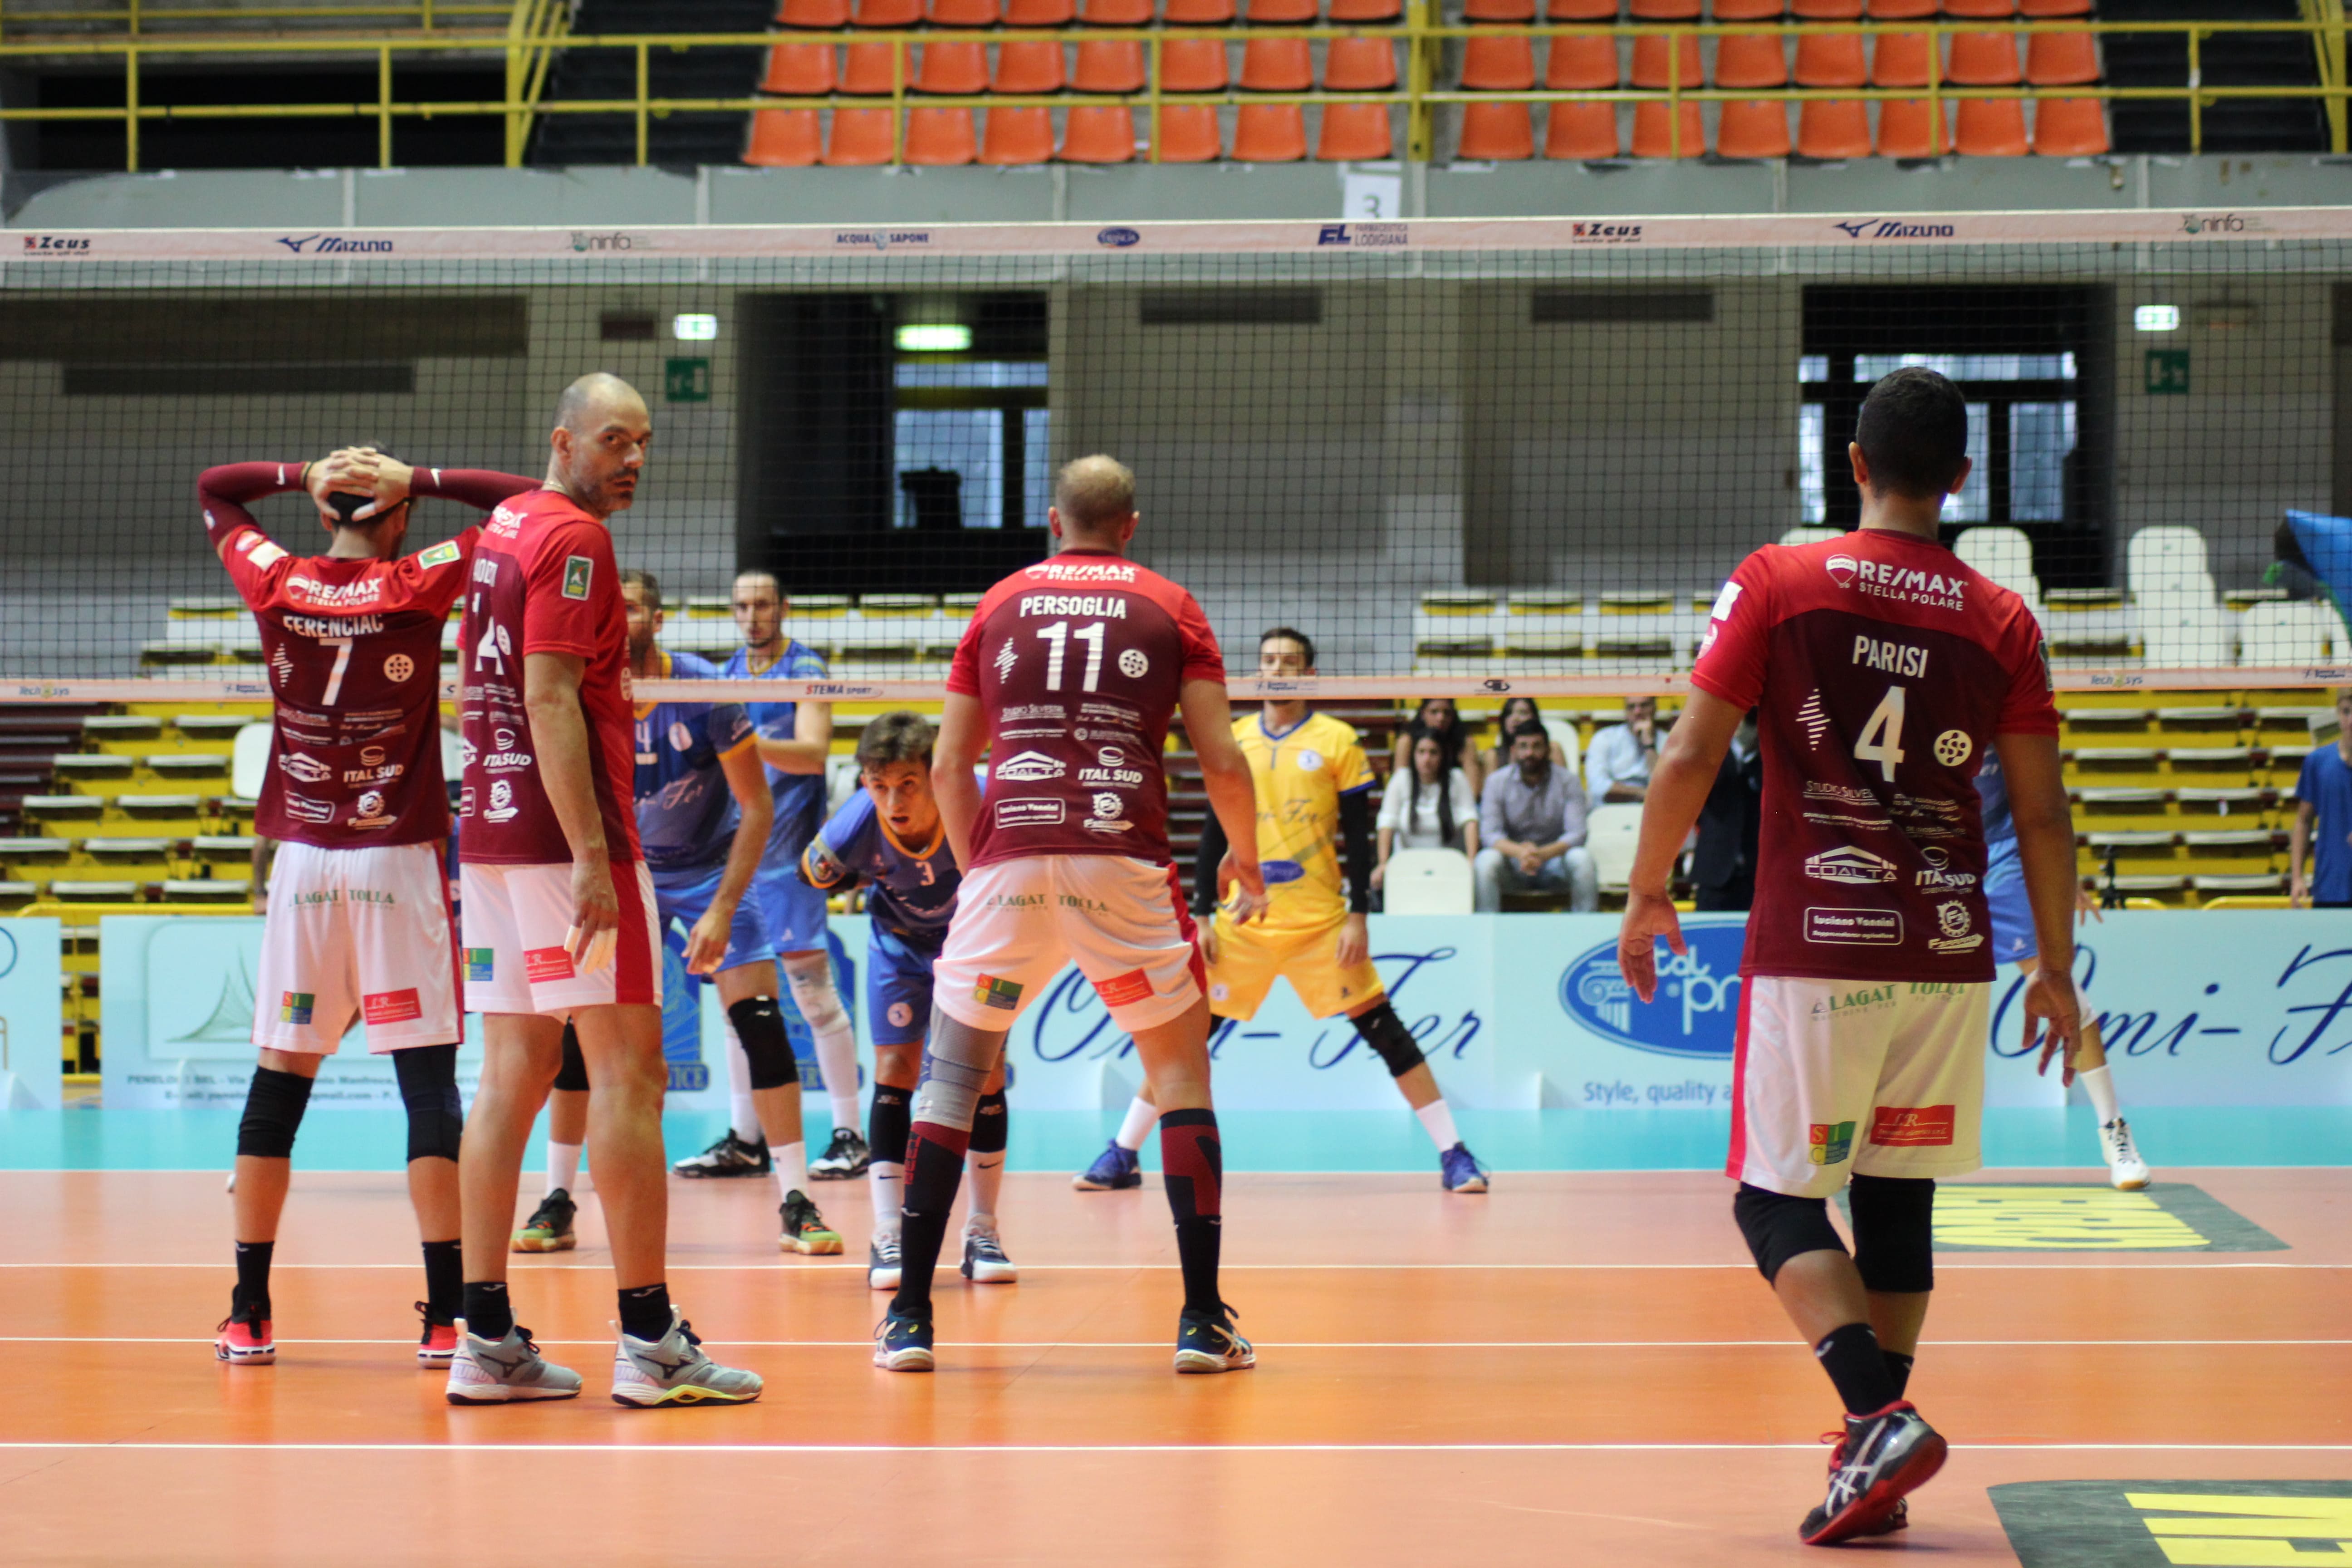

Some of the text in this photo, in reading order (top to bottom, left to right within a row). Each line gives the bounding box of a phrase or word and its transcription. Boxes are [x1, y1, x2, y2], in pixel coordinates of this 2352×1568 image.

[1589, 223, 1642, 235] Zeus
[2201, 214, 2244, 232] ninfa
[39, 237, 90, 249] Zeus
[590, 232, 631, 250] ninfa
[837, 233, 929, 244] ACQUA SAPONE
[1355, 234, 1407, 246] LODIGIANA
[1047, 564, 1135, 577] RE/MAX
[1092, 575, 1135, 583] POLARE
[1859, 560, 1964, 599] RE/MAX
[309, 578, 382, 600] RE/MAX
[1859, 582, 1964, 611] STELLA POLARE
[305, 593, 380, 607] STELLA POLARE
[1019, 595, 1127, 619] PERSOGLIA
[1036, 621, 1105, 693] 11
[1852, 636, 1928, 679] PARISI
[319, 638, 353, 706] 7
[805, 684, 844, 695] STEMA
[1853, 686, 1906, 782] 4
[483, 752, 532, 767] ITA SUD
[343, 769, 374, 783] ITAL
[376, 764, 404, 779] SUD
[1078, 768, 1143, 784] ITAL SUD
[915, 861, 936, 886] 3
[1805, 864, 1897, 882] COALTA
[1915, 869, 1977, 887] ITA SUD
[294, 889, 396, 905] LAGAT TOLLA
[998, 894, 1045, 907] LAGAT
[1829, 983, 1896, 1011] LAGAT
[1584, 1081, 1638, 1103] Style,
[1646, 1080, 1718, 1105] quality
